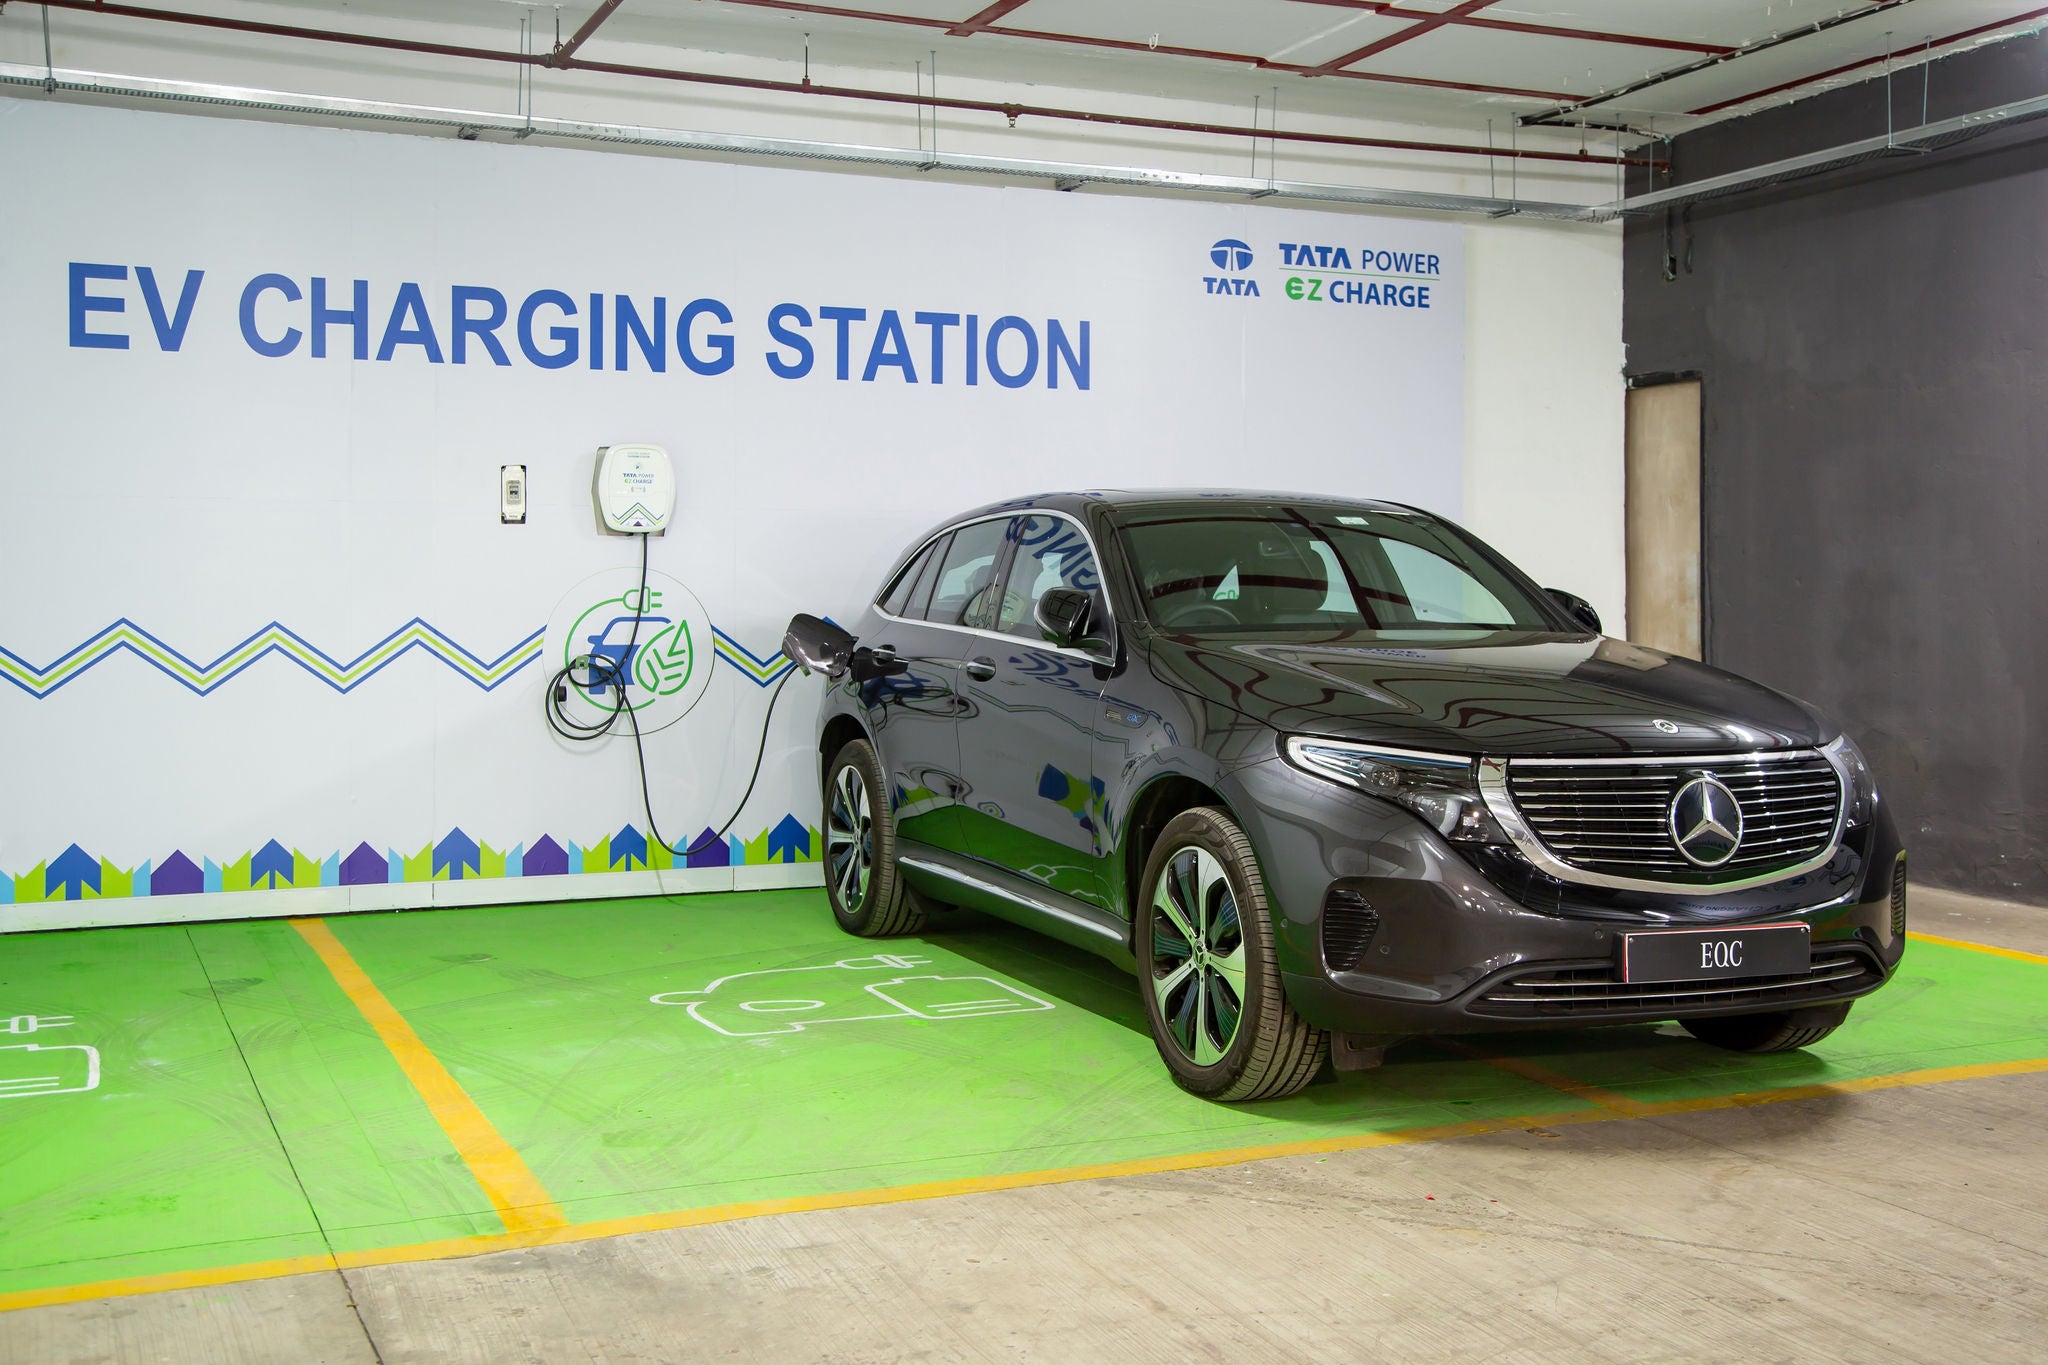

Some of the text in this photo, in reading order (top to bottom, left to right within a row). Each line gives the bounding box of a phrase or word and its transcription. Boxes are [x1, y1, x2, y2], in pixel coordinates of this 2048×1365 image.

[1279, 243, 1440, 275] TATA POWER
[1203, 276, 1260, 297] TATA
[1329, 280, 1430, 308] CHARGE
[69, 261, 1091, 391] EV CHARGING STATION
[1700, 940, 1743, 969] EQC
